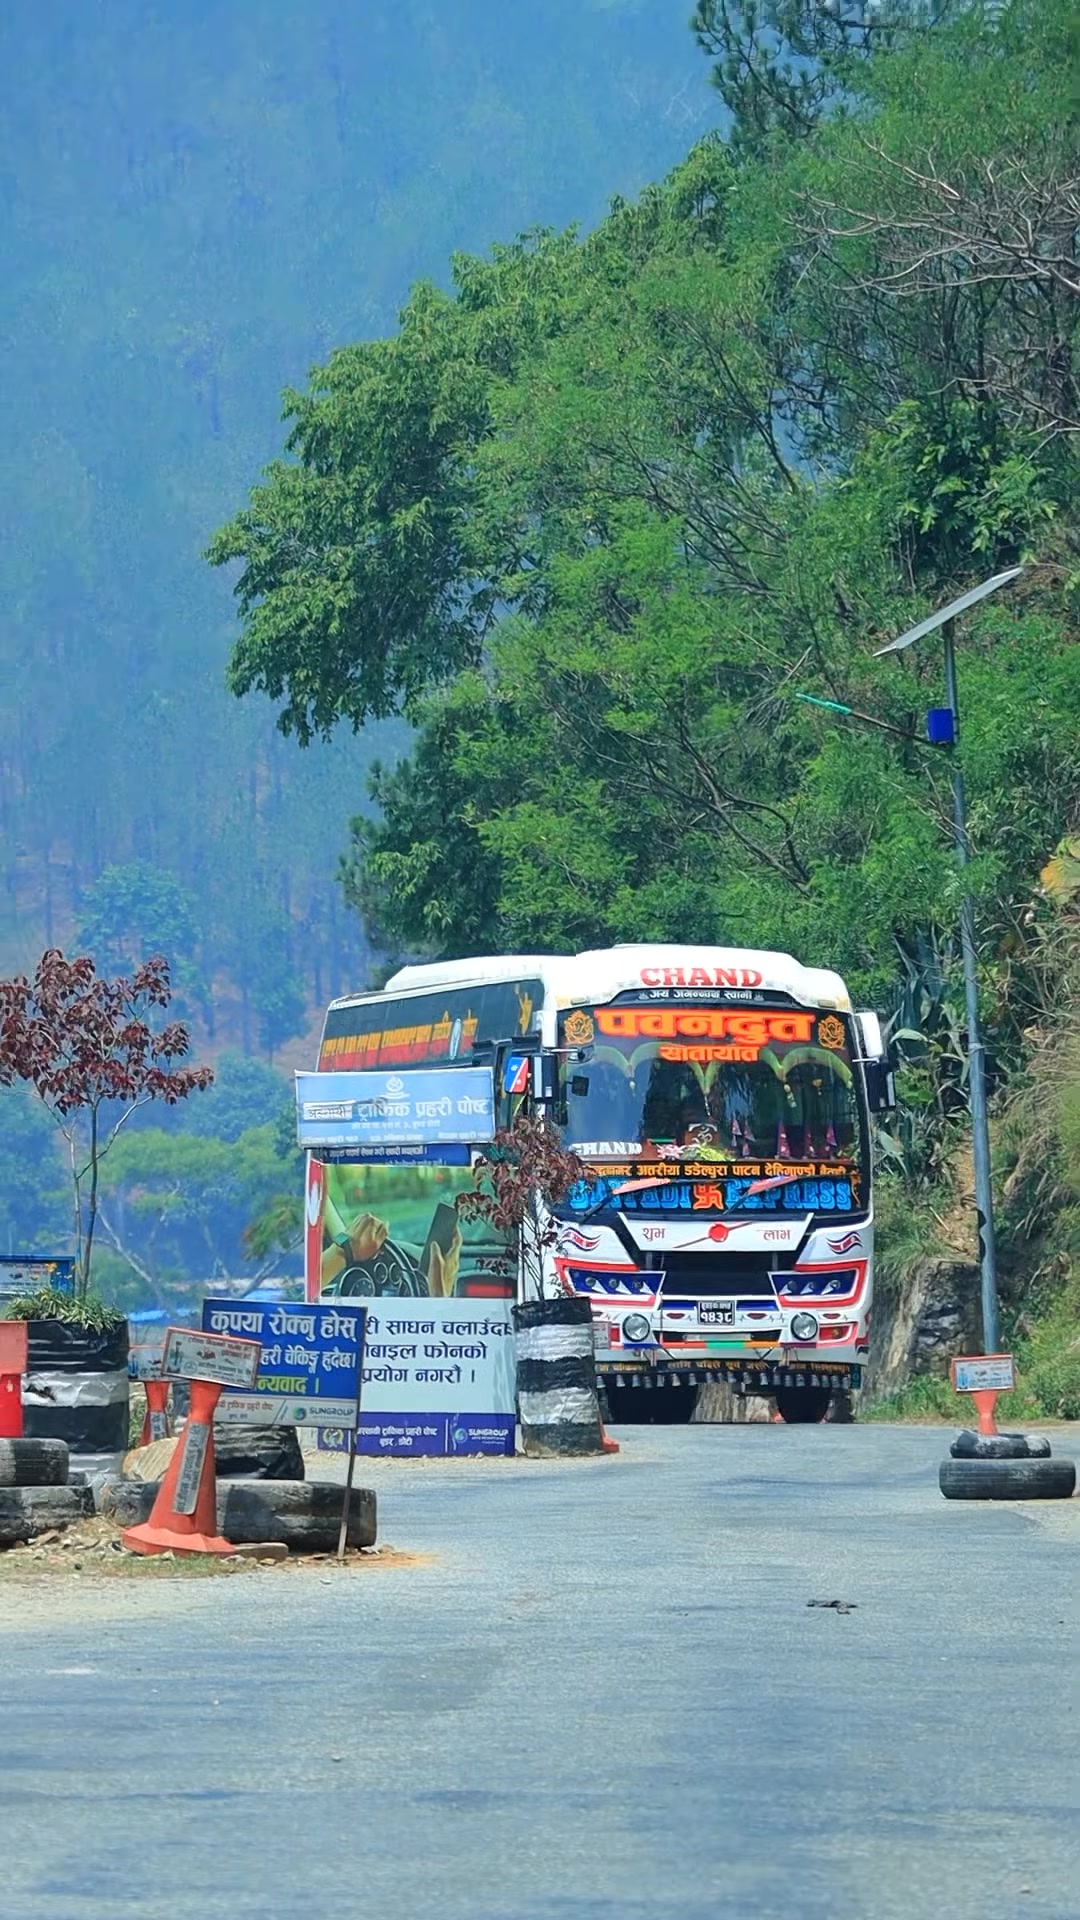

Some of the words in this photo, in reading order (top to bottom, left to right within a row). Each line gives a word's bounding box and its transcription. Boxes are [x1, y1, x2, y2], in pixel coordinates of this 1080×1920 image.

[640, 968, 763, 987] CHAND
[415, 1097, 452, 1117] प्रहरी
[642, 1227, 665, 1241] शुभ
[763, 1229, 791, 1240] लाभ
[210, 1310, 265, 1338] कृपया
[269, 1307, 317, 1342] रोक्नु
[320, 1310, 358, 1343] होस्
[701, 1312, 732, 1324] १४३८
[386, 1320, 436, 1335] साधन
[365, 1342, 418, 1360] ोबाइल
[424, 1341, 488, 1360] फोनको
[256, 1375, 309, 1394] न्यवाद
[309, 1407, 355, 1416] SUNGROUP
